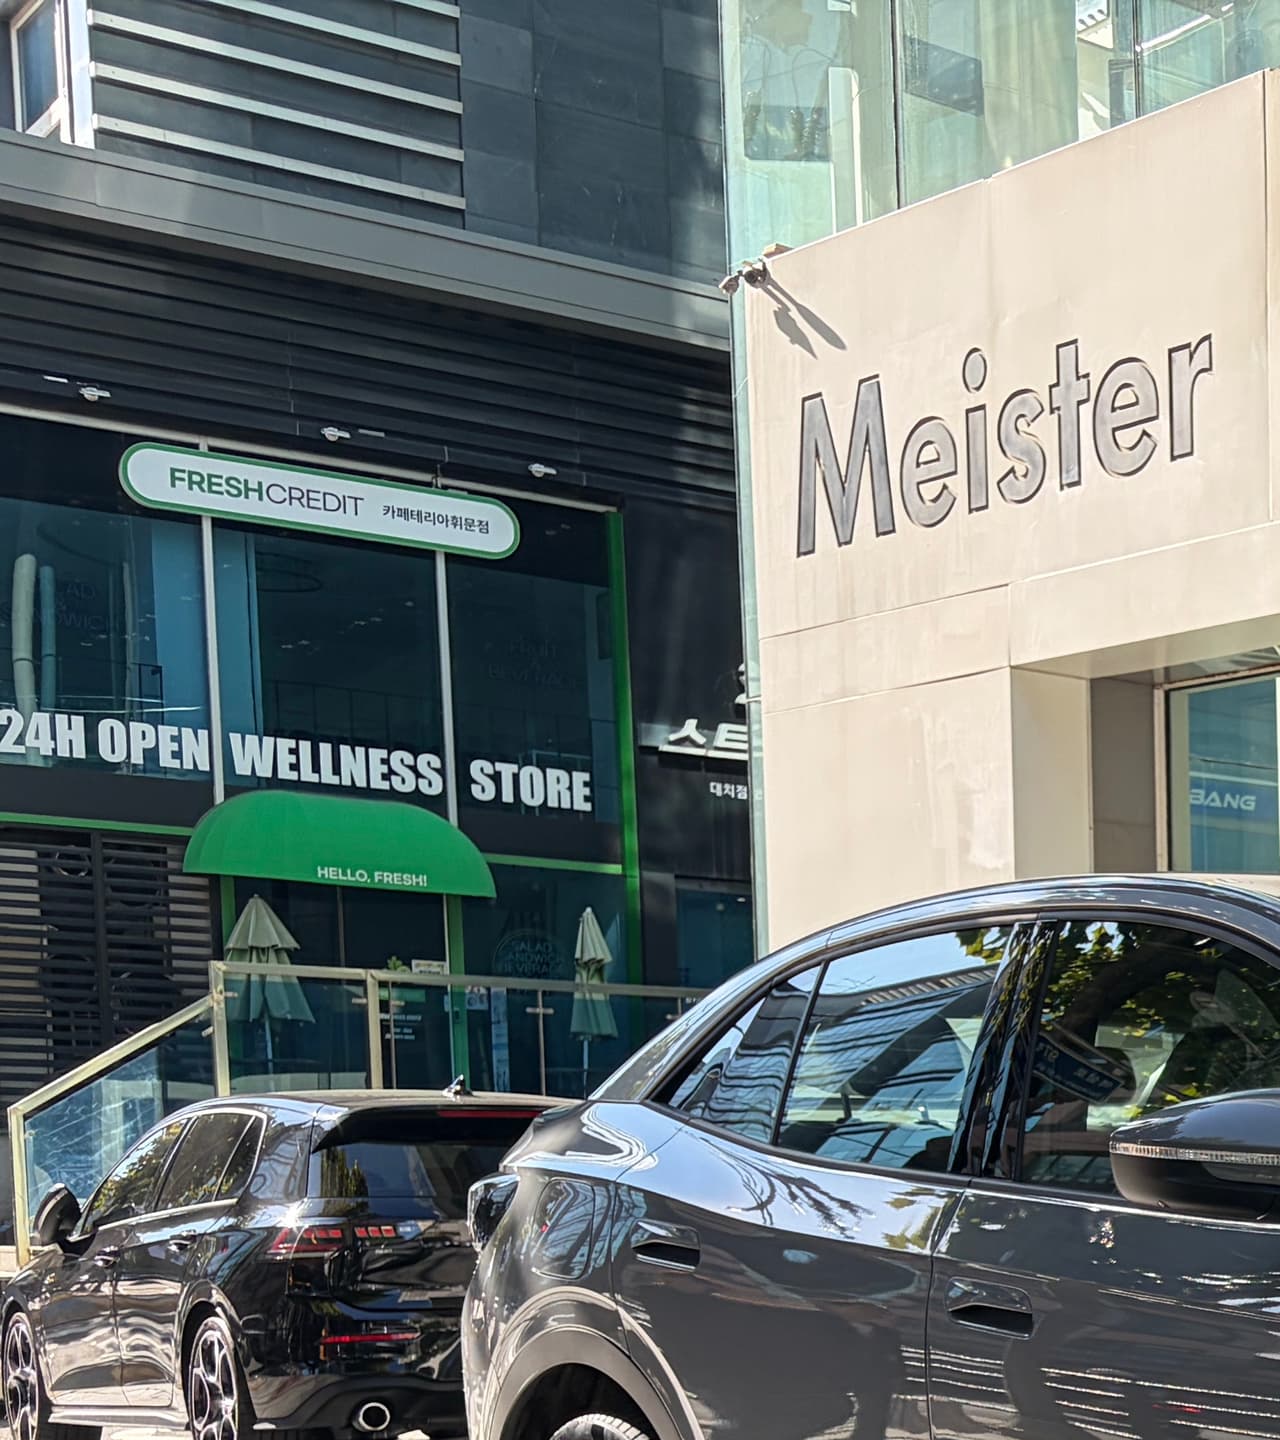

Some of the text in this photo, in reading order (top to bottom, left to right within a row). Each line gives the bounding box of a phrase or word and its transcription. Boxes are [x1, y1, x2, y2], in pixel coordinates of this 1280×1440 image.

[796, 331, 1213, 558] Meister
[0, 708, 593, 812] 24H OPEN WELLNESS STORE
[316, 865, 428, 887] HELLO, FRESH!
